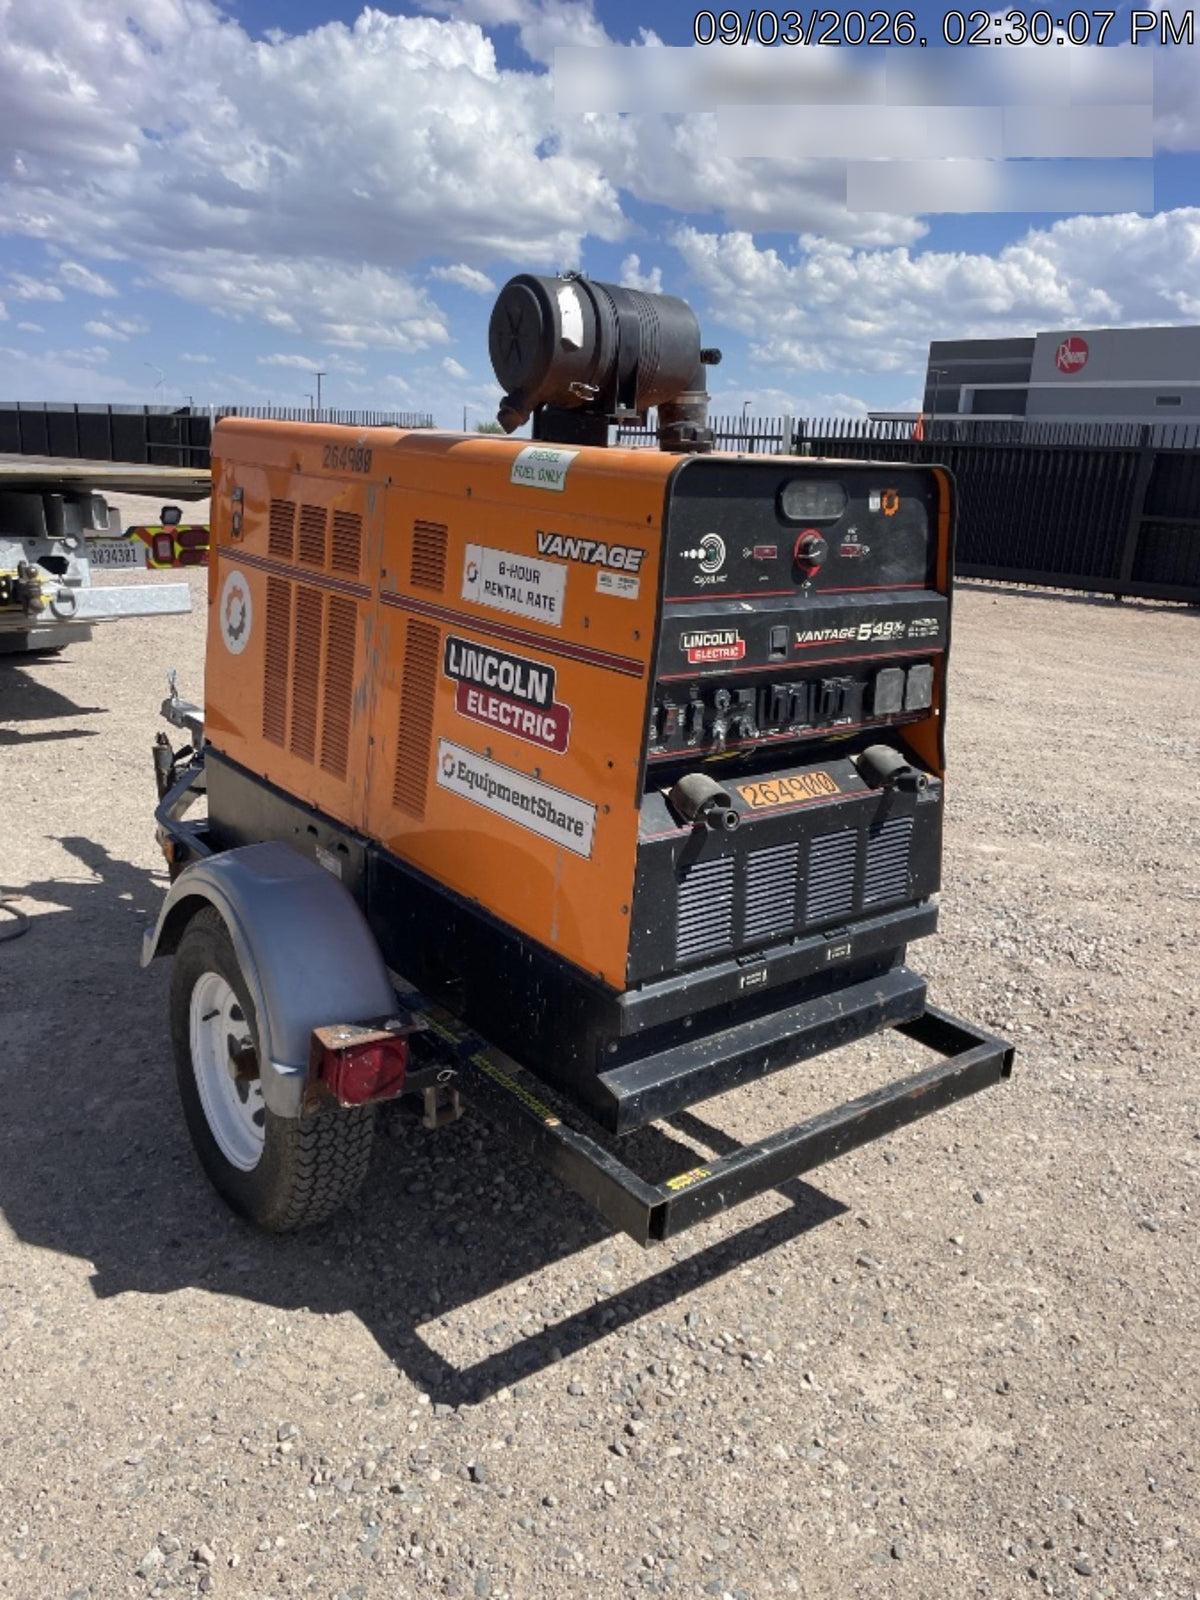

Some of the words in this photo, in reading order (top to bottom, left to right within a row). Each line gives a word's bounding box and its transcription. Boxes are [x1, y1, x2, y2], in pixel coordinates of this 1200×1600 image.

[513, 464, 535, 480] FUEL
[538, 467, 563, 484] ONLY
[536, 531, 645, 572] VANTAGE
[484, 580, 523, 604] RENTAL
[526, 591, 556, 613] RATE
[684, 632, 735, 648] LINCOLN
[795, 627, 856, 643] VANTAGE
[695, 646, 739, 660] ELECTRIC
[449, 643, 549, 705] LINCOLN
[466, 689, 558, 742] ELECTRIC
[457, 760, 585, 838] EquipmentShare
